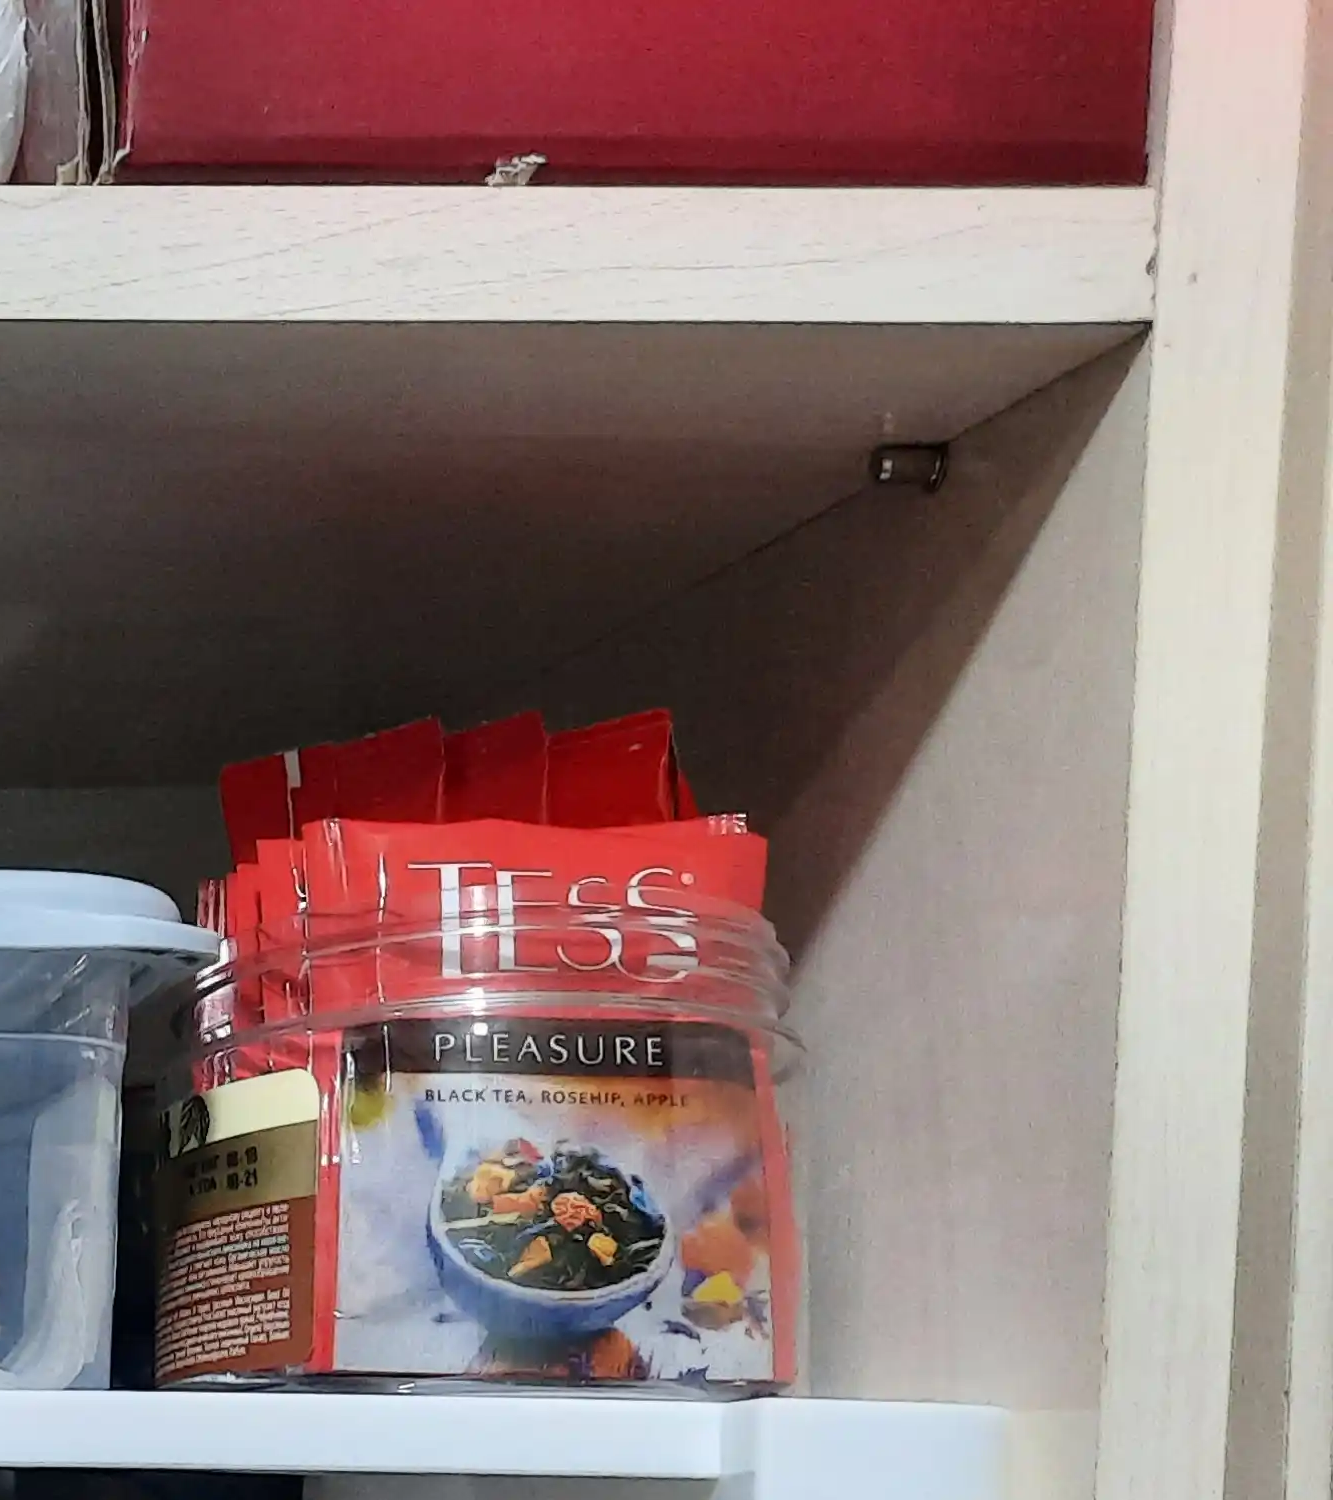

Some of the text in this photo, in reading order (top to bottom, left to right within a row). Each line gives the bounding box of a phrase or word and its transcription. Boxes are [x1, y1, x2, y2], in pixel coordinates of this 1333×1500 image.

[433, 1032, 664, 1067] PLEASURE
[424, 1088, 486, 1104] BLACK
[493, 1089, 533, 1105] TEA,
[634, 1092, 689, 1108] APPLE
